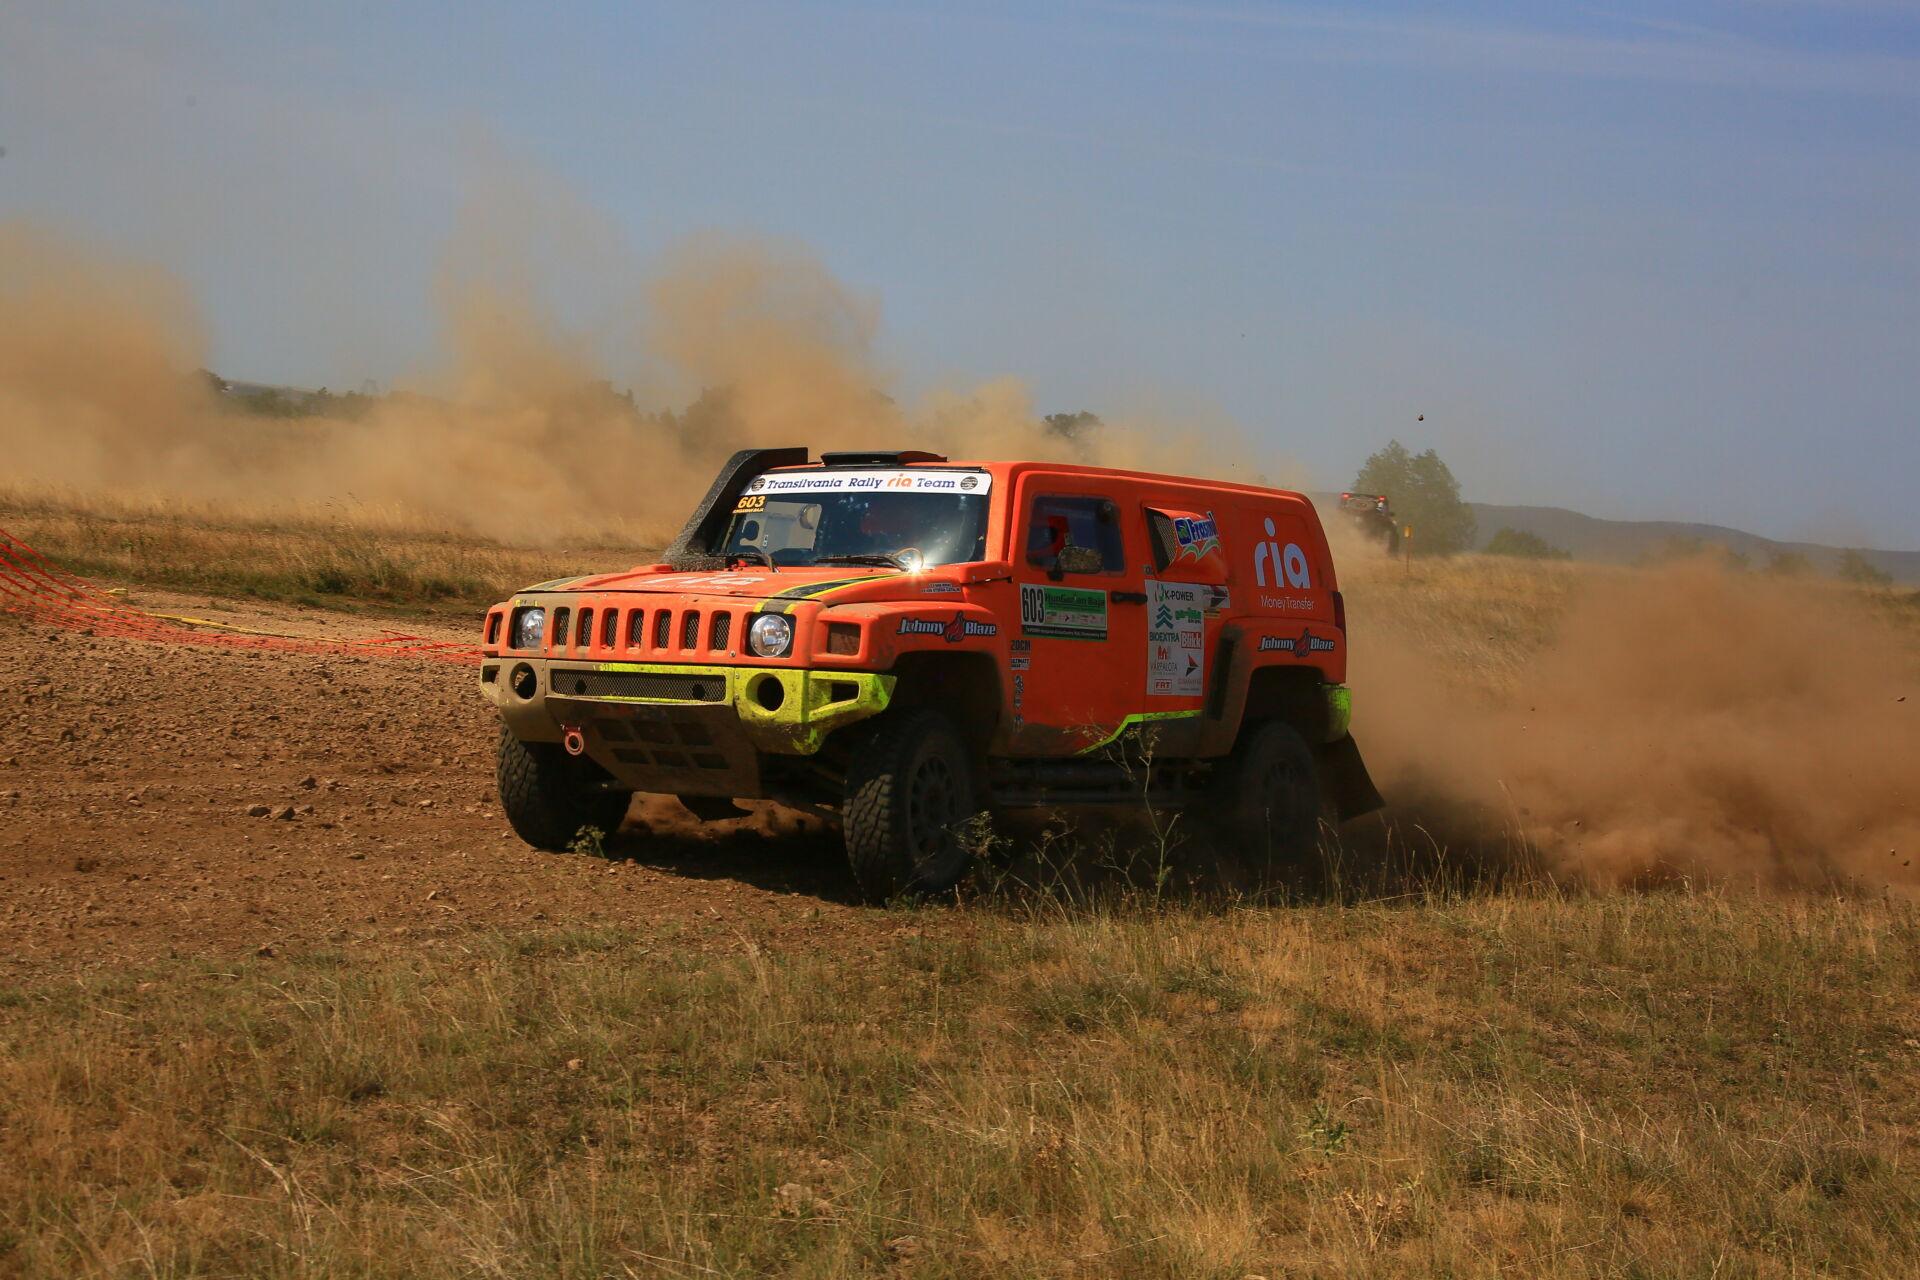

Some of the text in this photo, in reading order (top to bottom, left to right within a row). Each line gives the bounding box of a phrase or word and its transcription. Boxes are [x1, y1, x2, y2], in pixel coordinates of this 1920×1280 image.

[767, 473, 955, 489] Transilvania Rally ria Team
[738, 496, 766, 508] 603
[1254, 517, 1311, 589] ria
[1164, 590, 1194, 601] K-POWER
[1022, 587, 1045, 624] 603
[896, 617, 997, 636] Johnny Blaze
[1149, 632, 1180, 643] BIOEXTRA
[1258, 636, 1334, 651] Johnny Blaze
[1155, 681, 1170, 689] FRT
